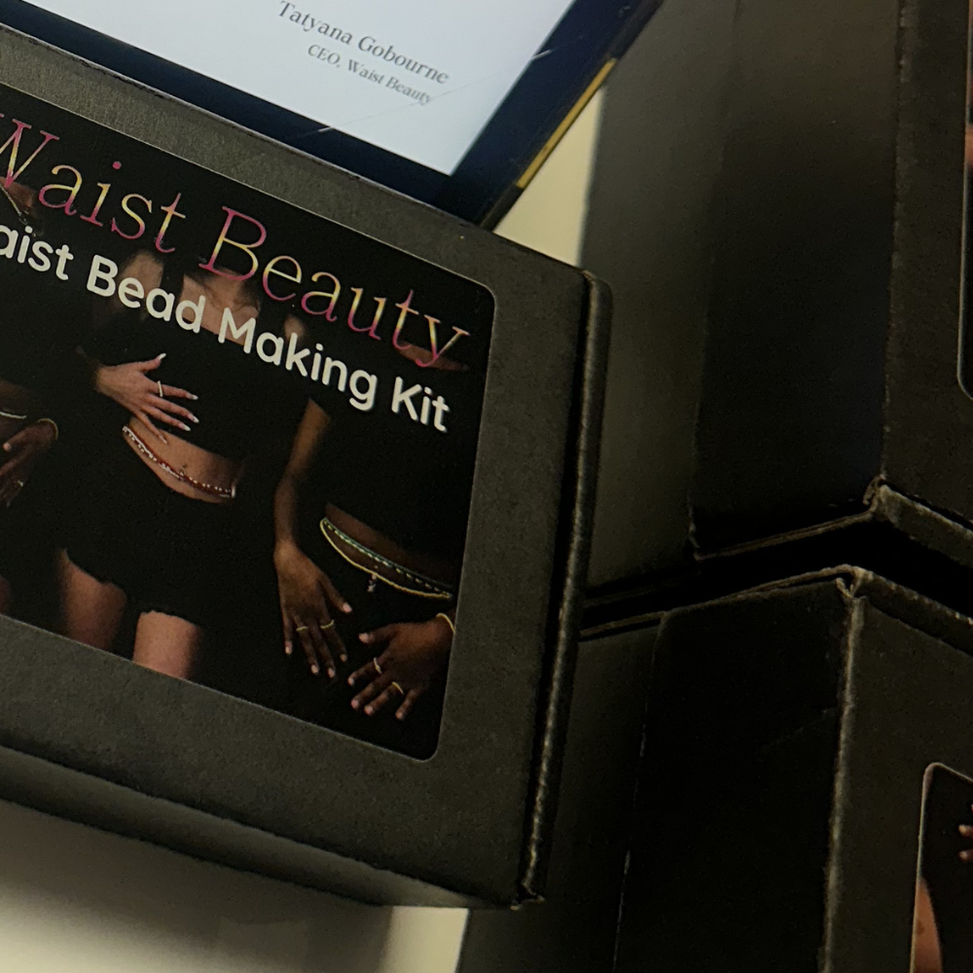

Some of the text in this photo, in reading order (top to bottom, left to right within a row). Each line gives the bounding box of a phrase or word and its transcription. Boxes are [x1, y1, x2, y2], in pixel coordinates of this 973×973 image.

[278, 0, 450, 85] Tatyana Gobourne
[307, 44, 432, 105] CEO, Waist Beauty
[86, 255, 207, 334] Bead
[218, 307, 378, 411] Making
[390, 377, 451, 433] Kit
[198, 206, 470, 368] Beauty
